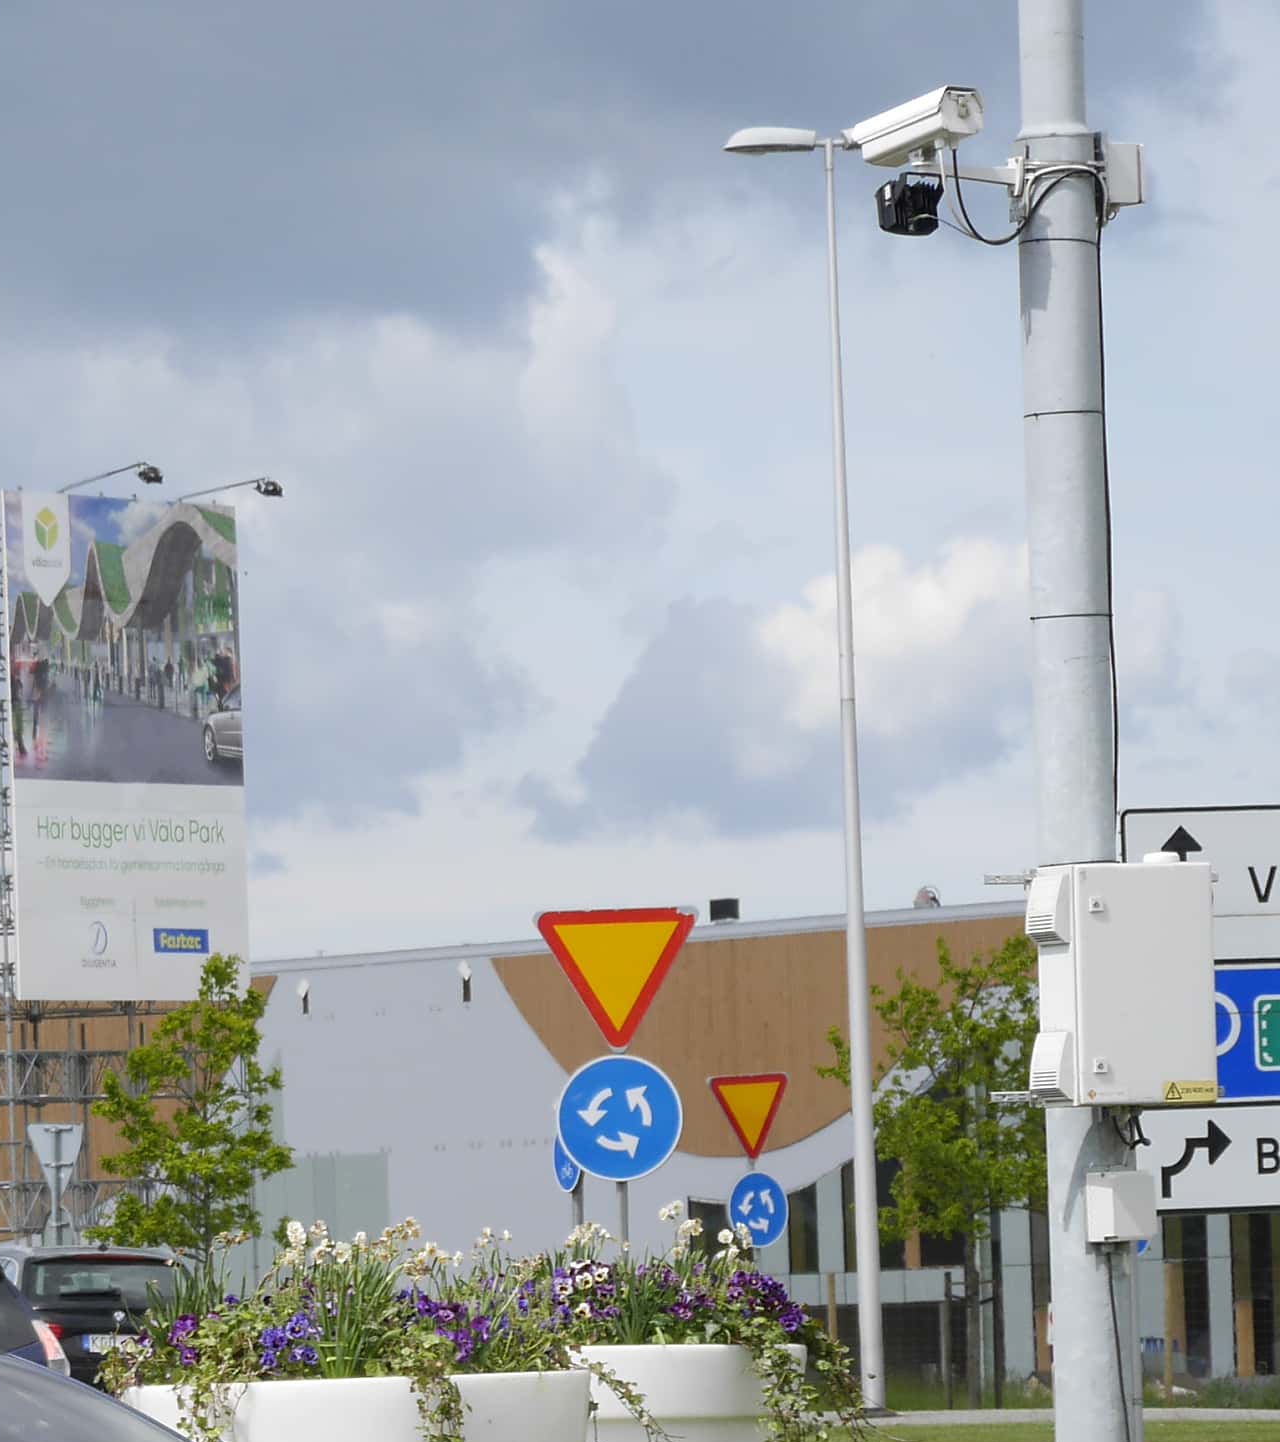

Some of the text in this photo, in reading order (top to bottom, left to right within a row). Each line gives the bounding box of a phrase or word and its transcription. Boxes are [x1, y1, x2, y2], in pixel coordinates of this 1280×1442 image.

[37, 815, 225, 848] Här bygger vi Väla Park
[1248, 866, 1278, 904] V
[159, 932, 202, 950] Fastec
